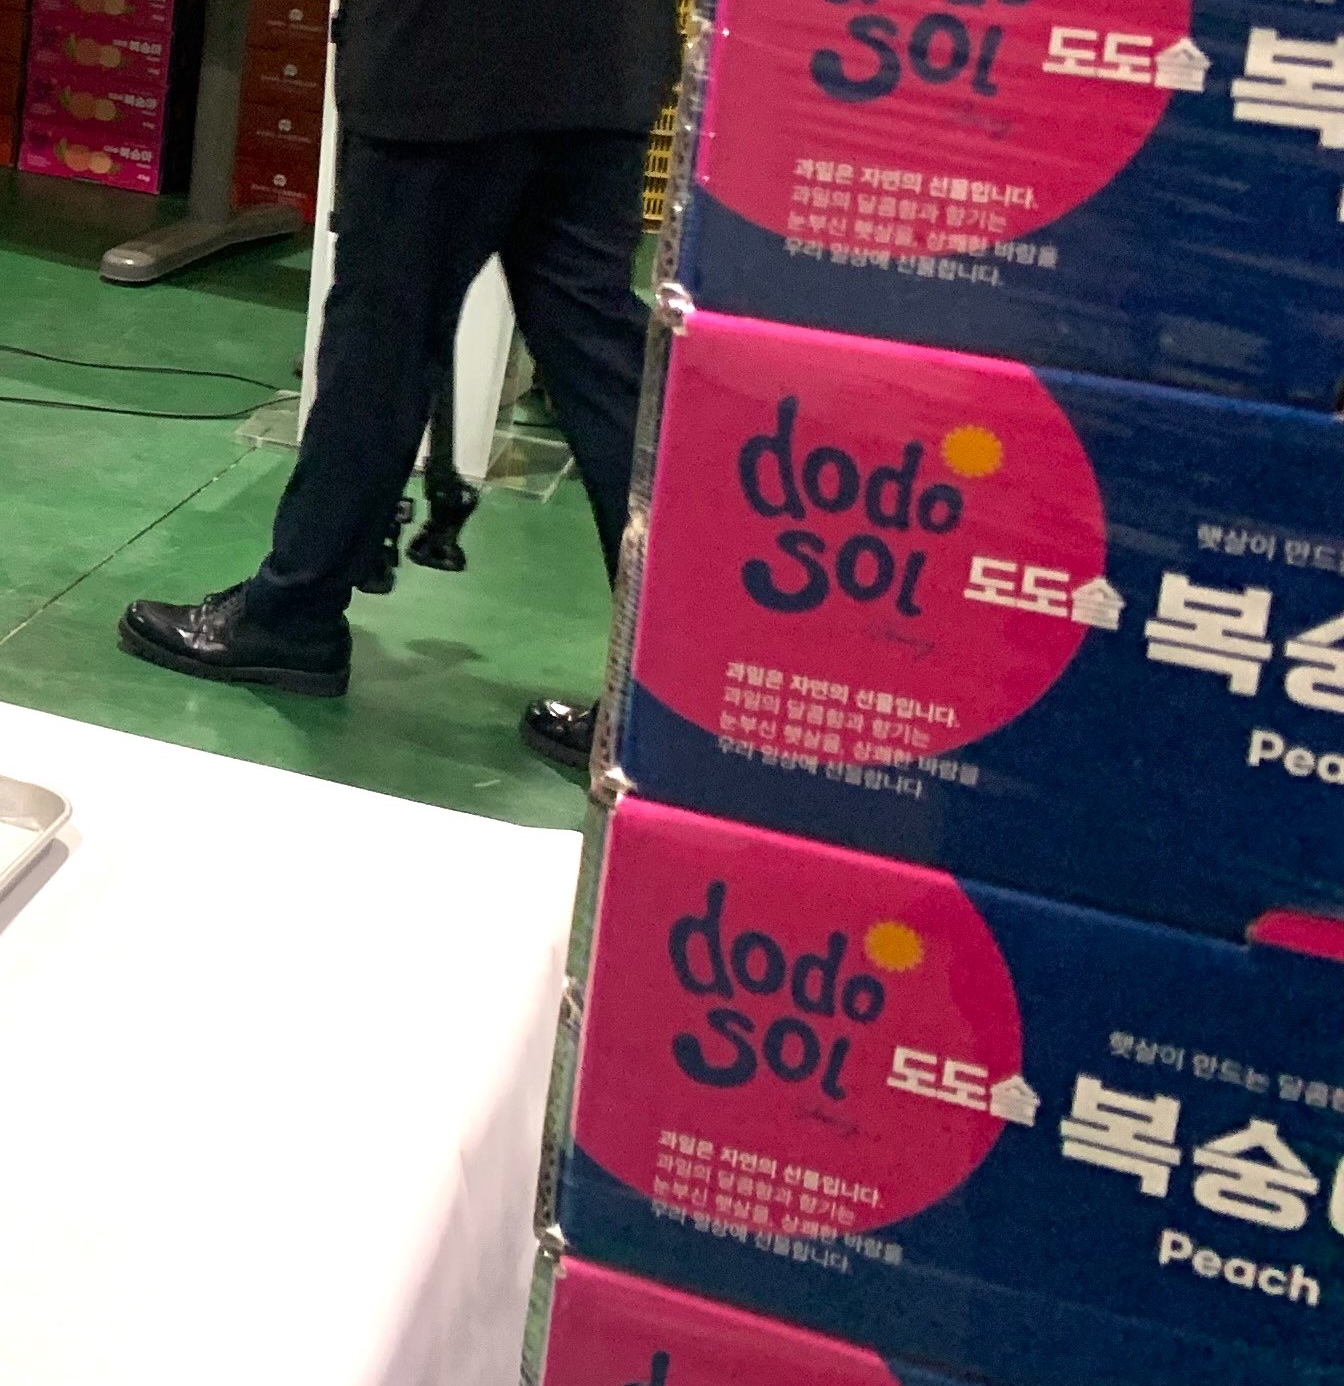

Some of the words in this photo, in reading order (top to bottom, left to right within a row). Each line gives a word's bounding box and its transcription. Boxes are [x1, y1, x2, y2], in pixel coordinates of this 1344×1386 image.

[809, 13, 1003, 103] sol
[1042, 25, 1211, 93] 도도솔
[738, 397, 963, 535] dodo
[742, 531, 928, 617] sol
[1197, 524, 1275, 561] 햇살이
[1283, 539, 1344, 576] 만드
[962, 556, 1126, 632] 도도솔
[726, 662, 784, 690] 과일은
[790, 674, 849, 704] 자연의
[669, 882, 884, 1025] dodo
[672, 1008, 850, 1100] sol
[1109, 1031, 1185, 1072] 햇살이
[1192, 1049, 1270, 1094] 만드는
[659, 1129, 713, 1160] 과일은
[721, 1146, 777, 1179] 자연의
[887, 1045, 1041, 1127] 도도솔
[1061, 1071, 1344, 1234] 복숭
[1159, 1228, 1320, 1308] Peach
